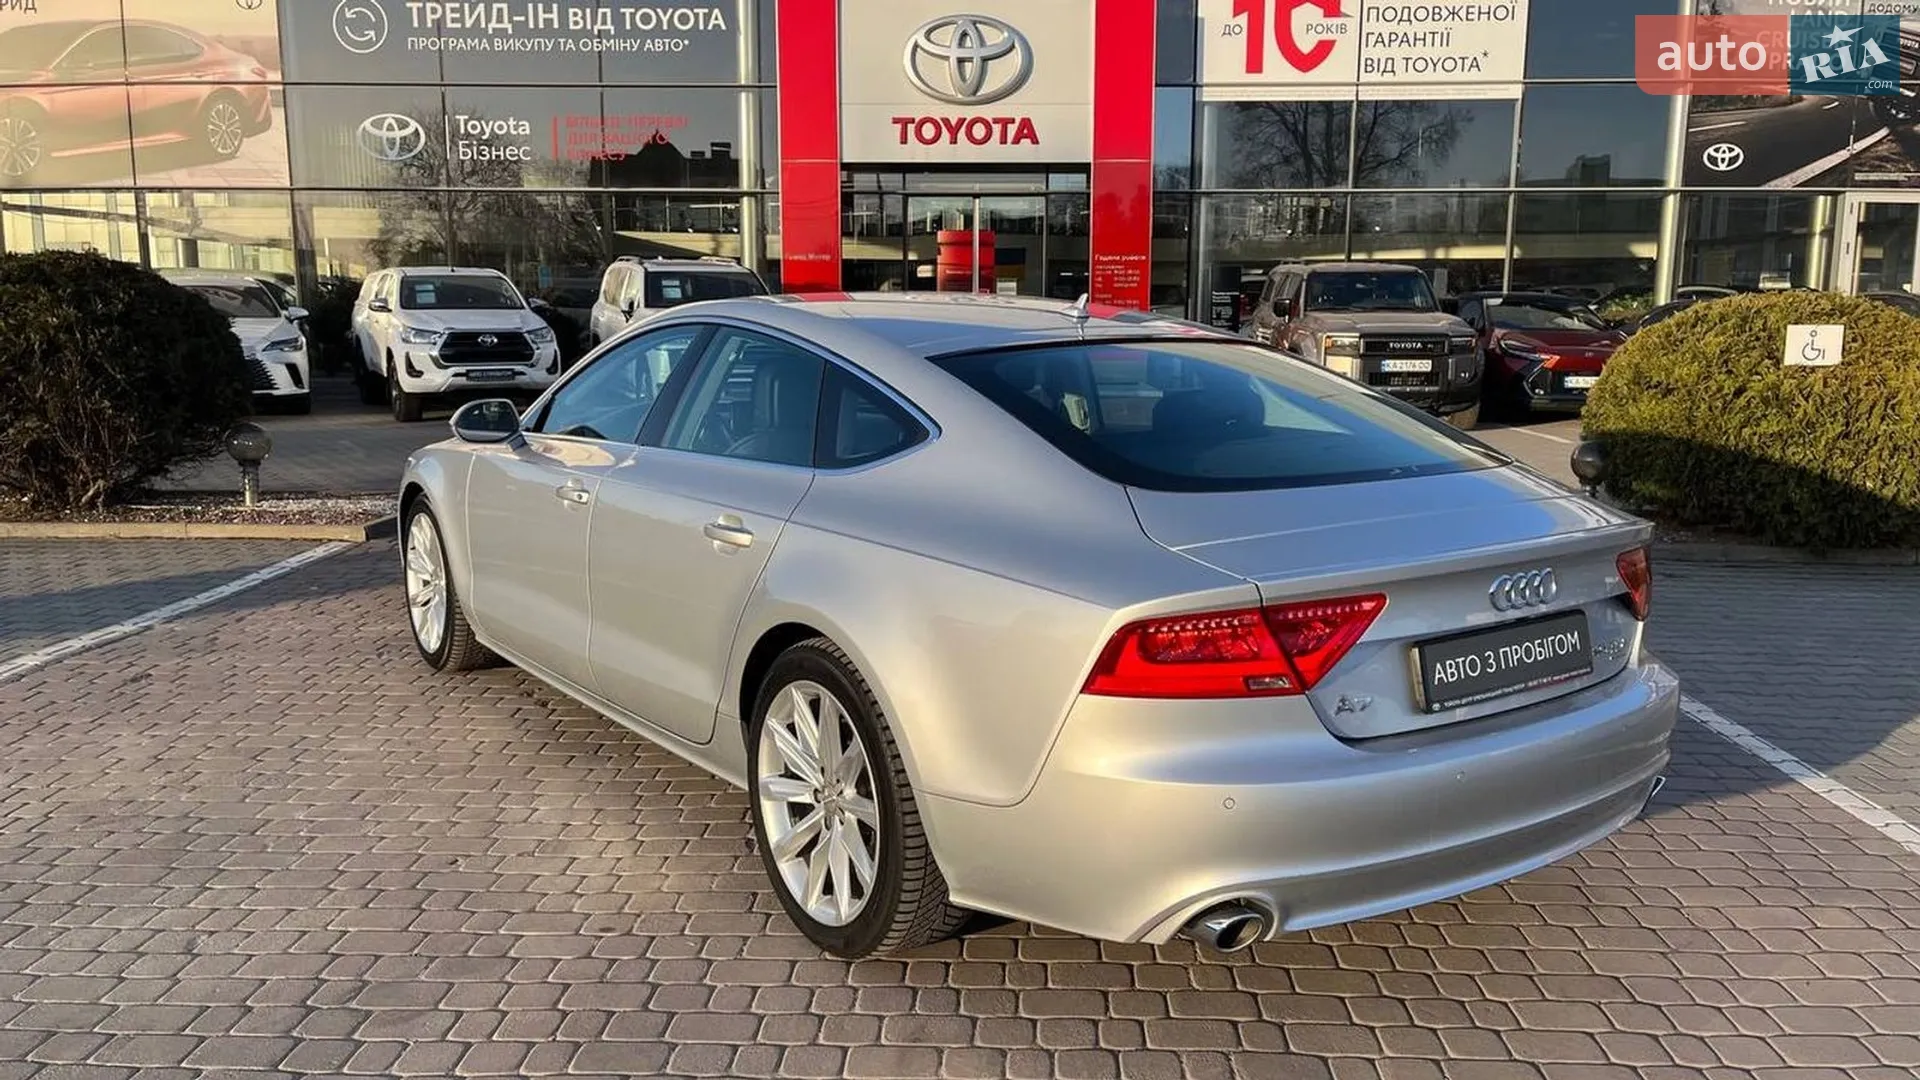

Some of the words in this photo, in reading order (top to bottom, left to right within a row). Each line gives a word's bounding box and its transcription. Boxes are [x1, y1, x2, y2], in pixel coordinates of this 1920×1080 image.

[406, 0, 559, 34] ТРЕЙД-ІН
[568, 8, 614, 35] ВІД
[620, 8, 727, 30] TOYOTA
[1367, 0, 1517, 25] ПОДОВЖЕНОЇ
[1221, 23, 1243, 37] ДО
[1306, 23, 1348, 35] РОКІВ
[1365, 27, 1453, 48] ГАРАНТІЇ
[408, 37, 490, 51] ПРОГРАМА
[494, 38, 554, 51] ВИКУПУ
[558, 38, 576, 51] ТА
[579, 39, 640, 52] ОБМІНУ
[1364, 57, 1396, 76] ВІД
[455, 115, 531, 139] Toyota
[891, 116, 1040, 145] TOYOTA
[459, 140, 532, 160] Бізнес
[1434, 655, 1481, 685] АВТО
[1500, 630, 1581, 670] ПРОБІГОМ
